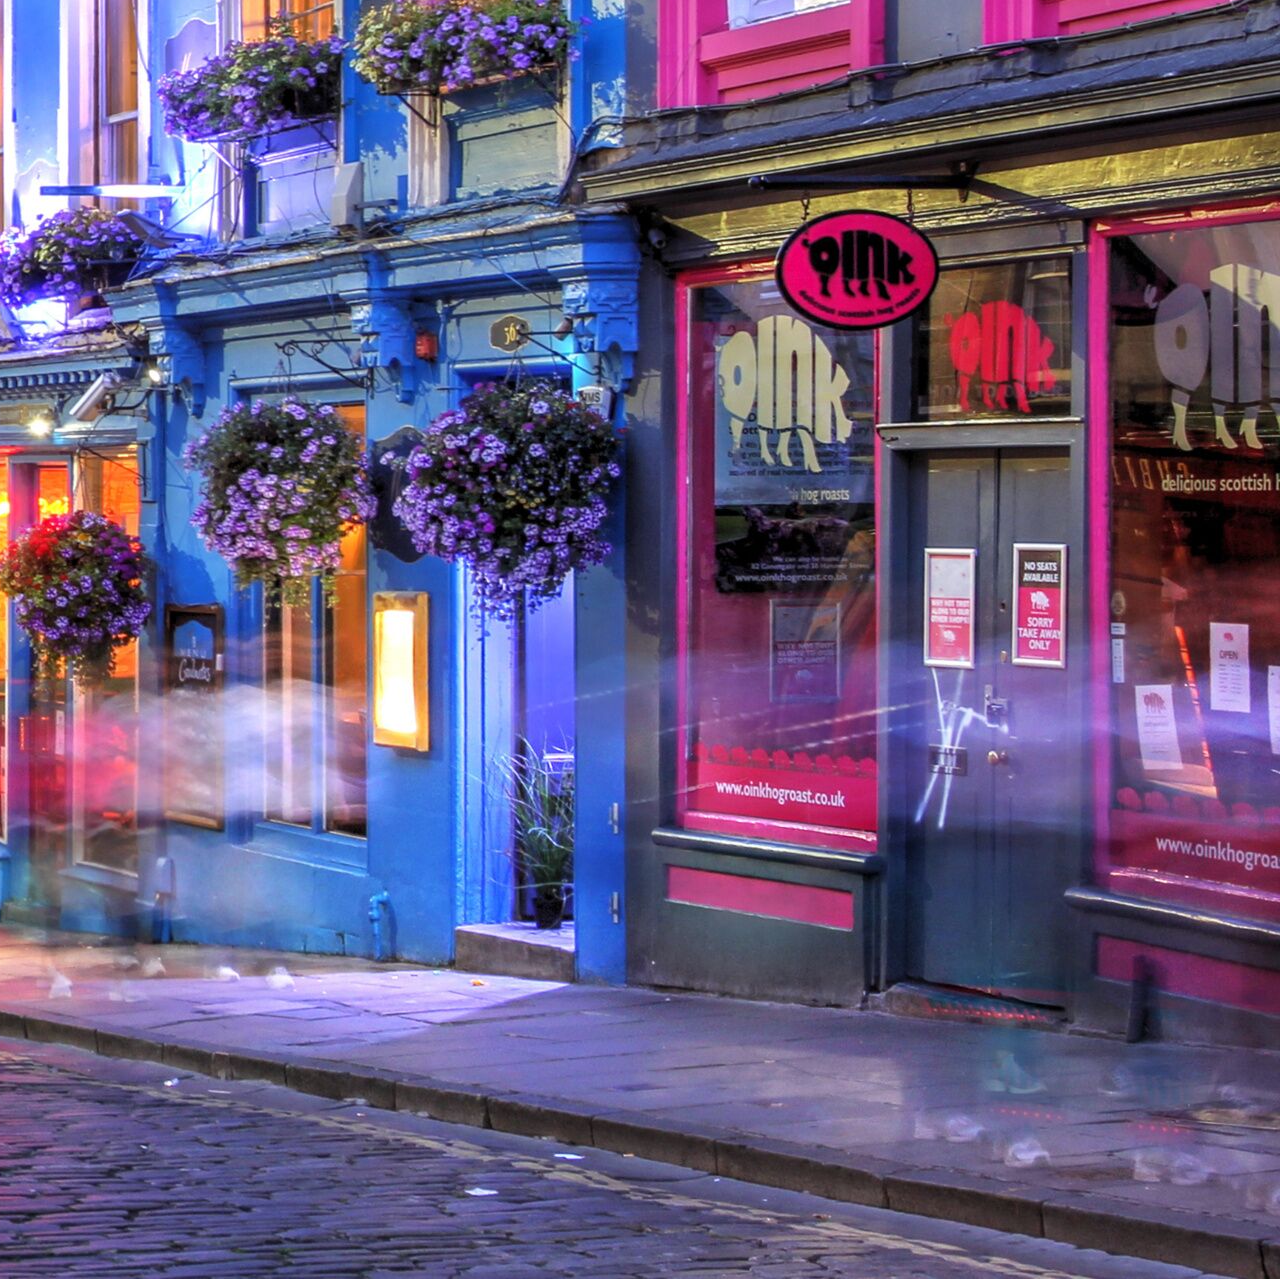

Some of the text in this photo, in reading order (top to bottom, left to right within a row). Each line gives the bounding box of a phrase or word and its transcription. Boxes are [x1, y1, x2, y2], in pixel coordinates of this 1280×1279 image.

[1162, 473, 1272, 492] delicious scottish
[820, 488, 850, 501] roasts
[1024, 561, 1057, 571] NO SEATS
[735, 572, 848, 583] www.oinkhogroast.co.uk
[1023, 574, 1059, 582] AVAILABLE
[1027, 617, 1054, 628] SORRY
[1018, 628, 1062, 639] TAKE AWAY
[1028, 639, 1051, 650] ONLY
[1219, 650, 1239, 660] OPEN
[715, 781, 846, 808] www.oinkhogroast.co.uk
